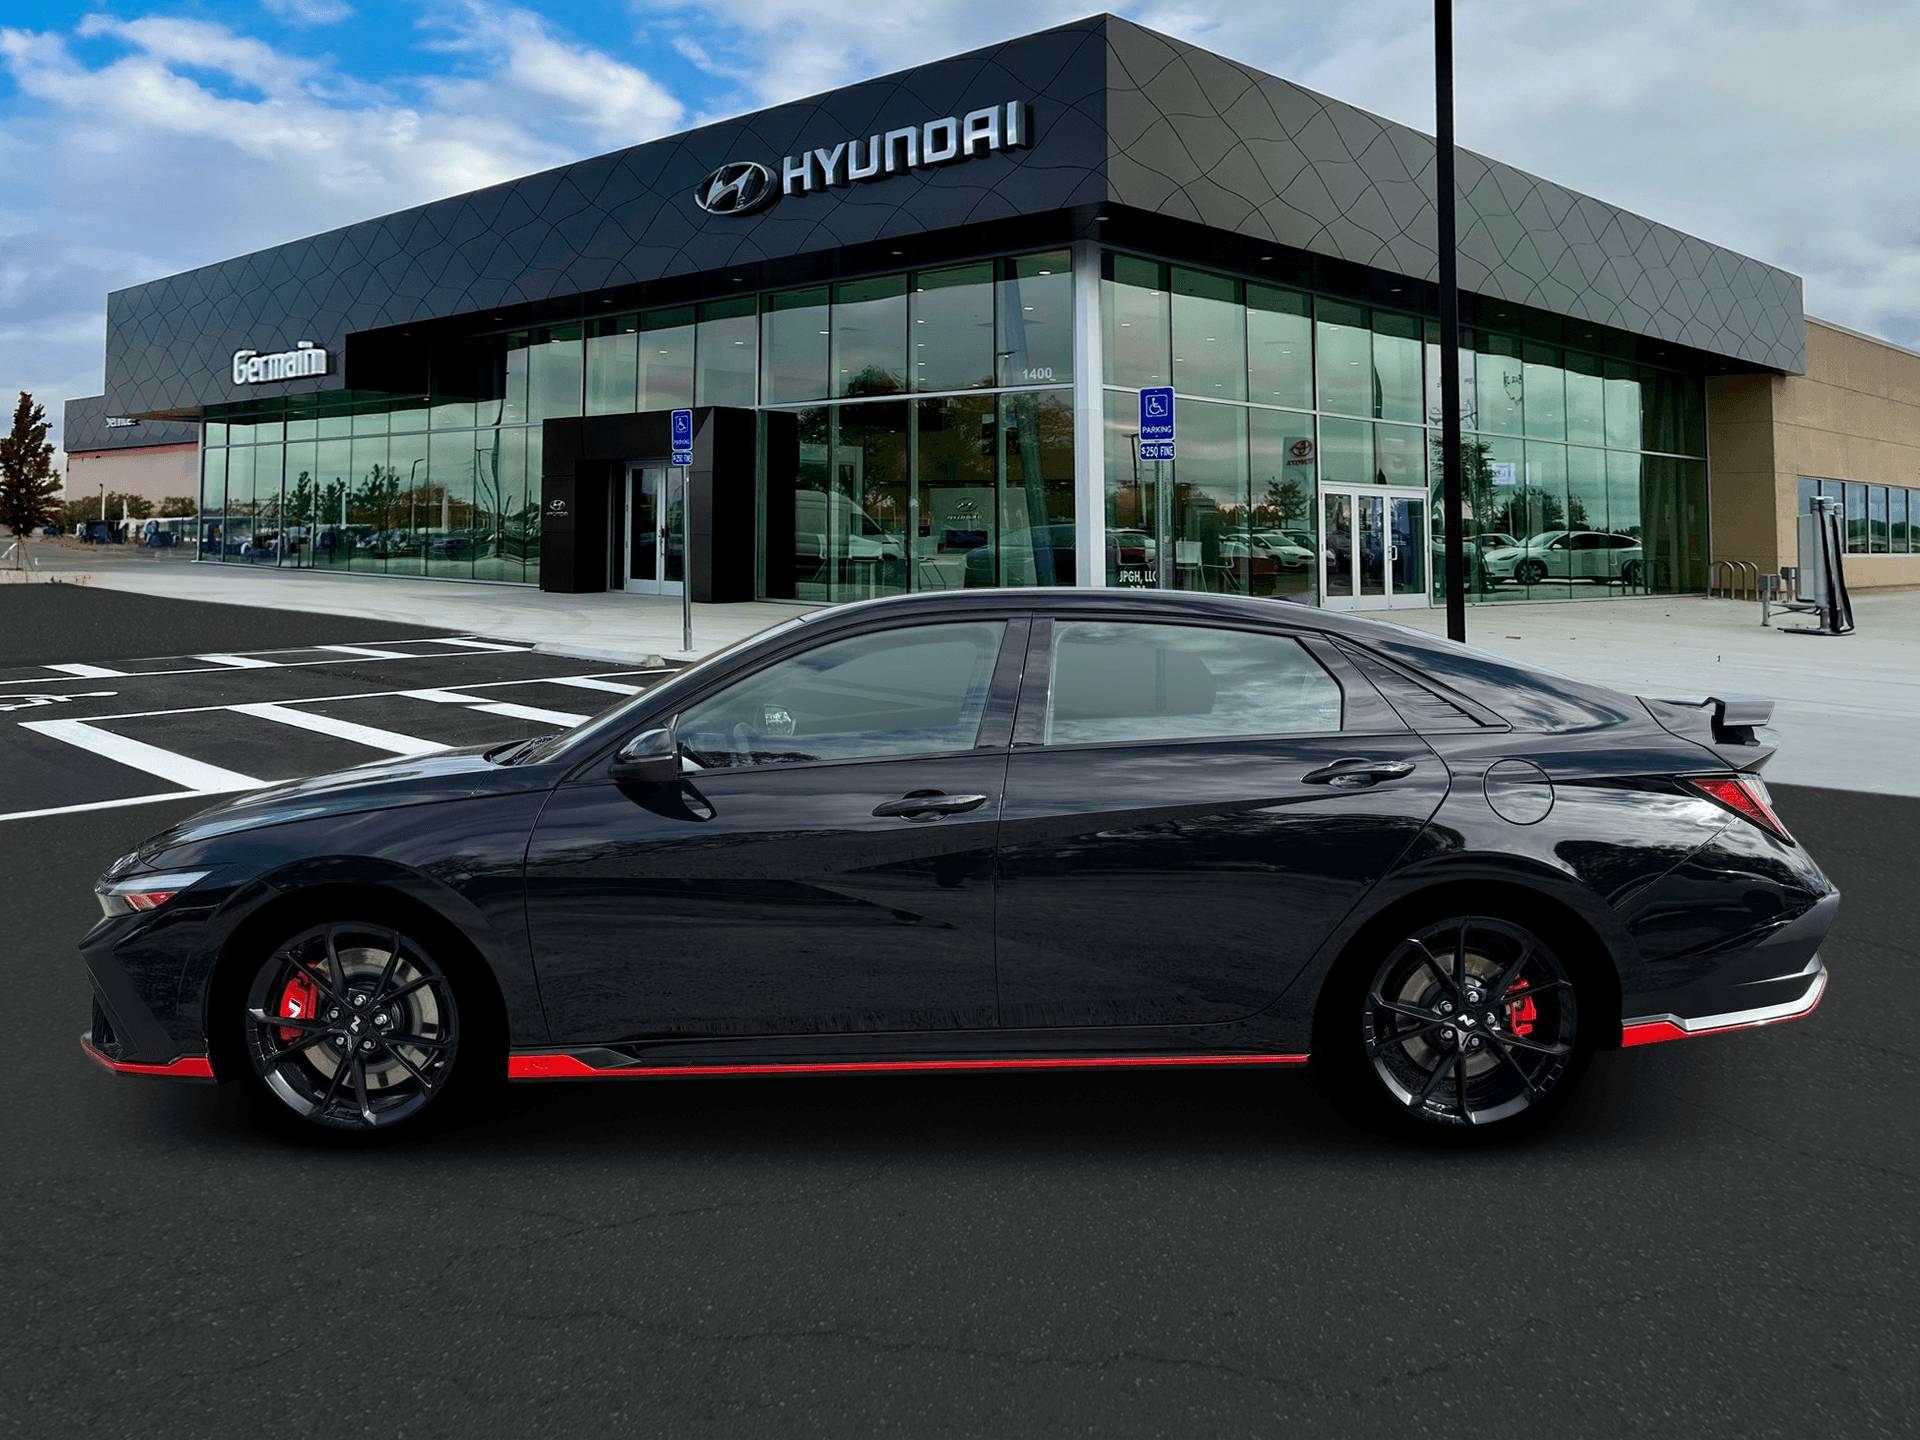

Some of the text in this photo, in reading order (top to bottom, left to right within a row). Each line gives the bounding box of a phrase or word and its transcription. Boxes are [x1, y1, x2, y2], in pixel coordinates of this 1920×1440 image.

[783, 100, 1024, 195] HYUNDAI
[233, 341, 327, 385] Germain
[1021, 366, 1053, 380] 1400
[1142, 425, 1172, 434] PARKING
[1119, 570, 1143, 584] JPGH,
